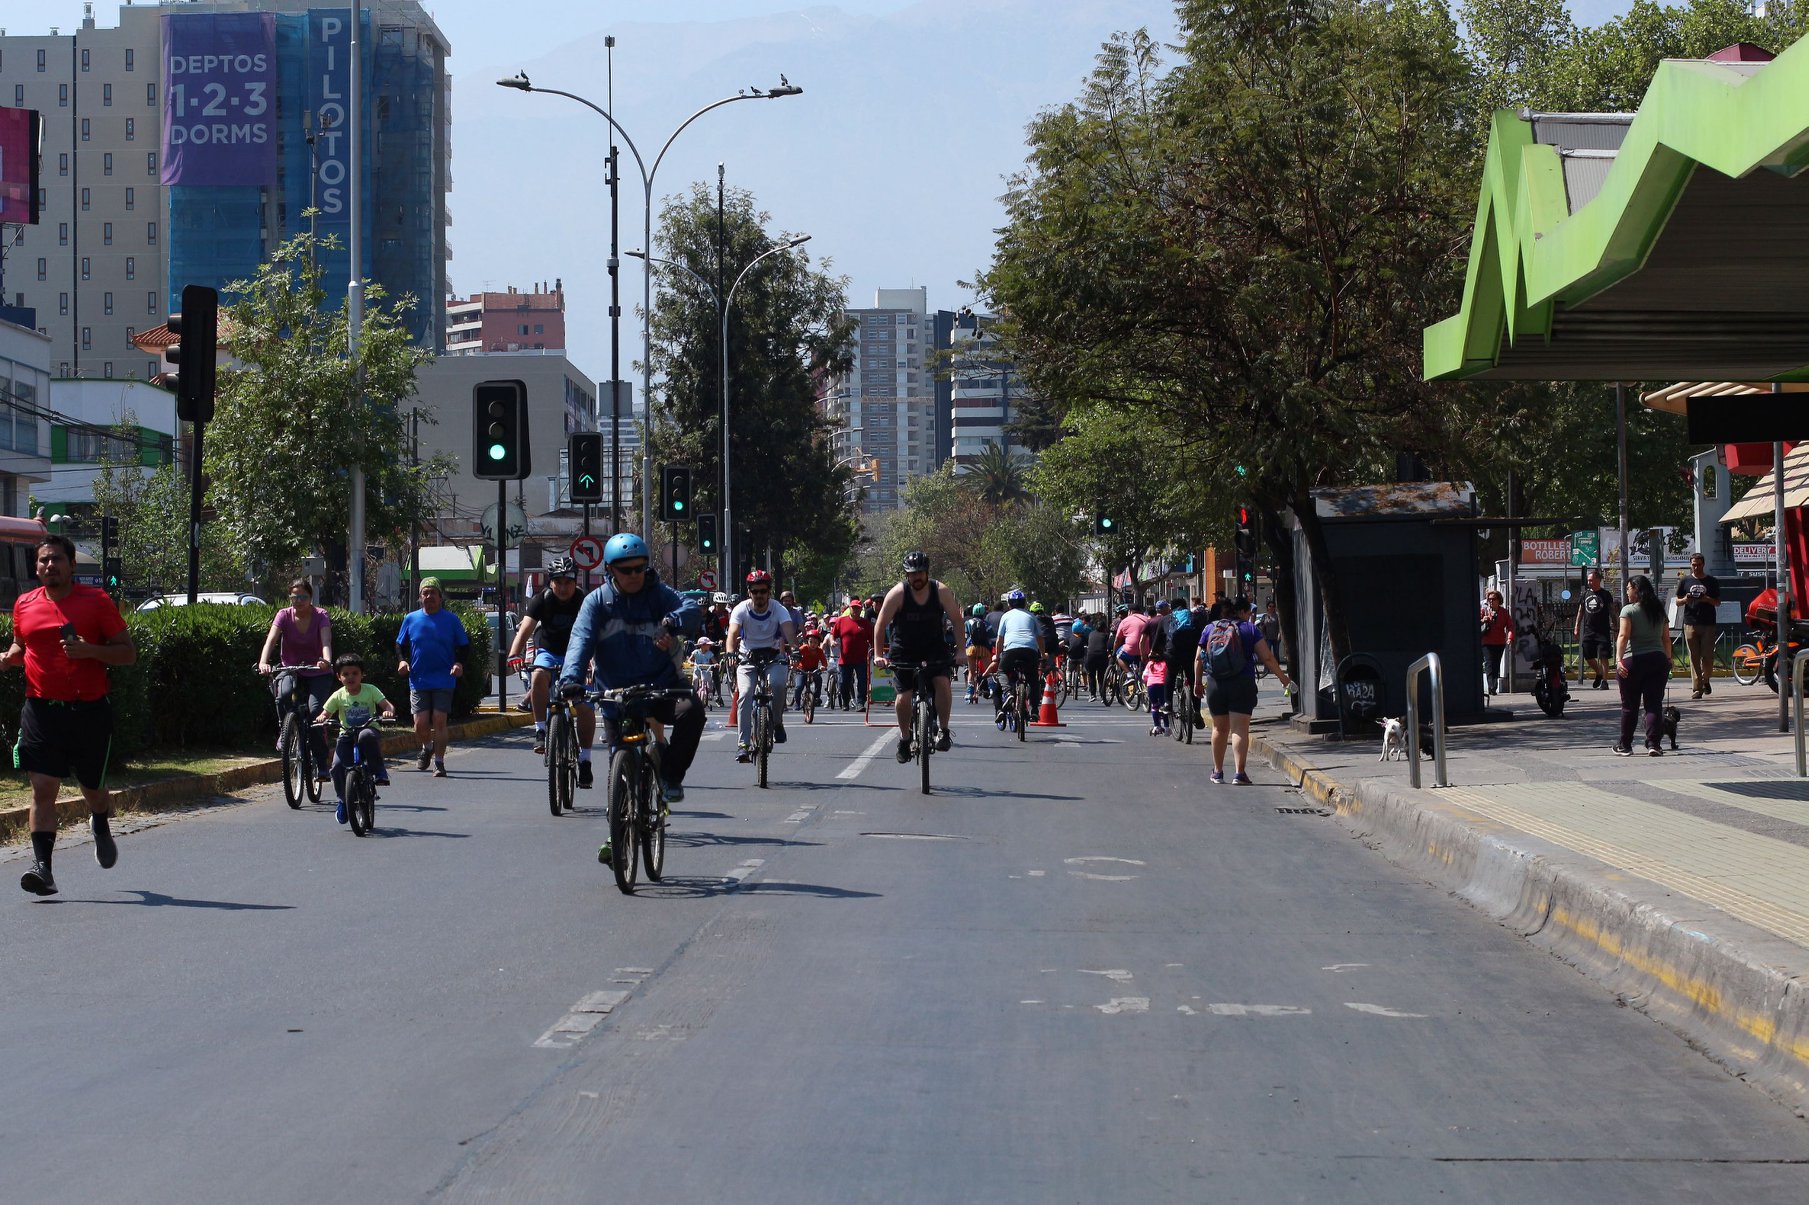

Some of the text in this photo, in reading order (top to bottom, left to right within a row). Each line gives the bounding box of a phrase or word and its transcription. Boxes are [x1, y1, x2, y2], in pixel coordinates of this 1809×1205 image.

[171, 54, 267, 74] DEPTOS
[319, 17, 346, 214] PILOTOS
[171, 123, 268, 145] DORMS
[1523, 541, 1571, 550] BOTILLER
[1535, 550, 1571, 560] ROBERT
